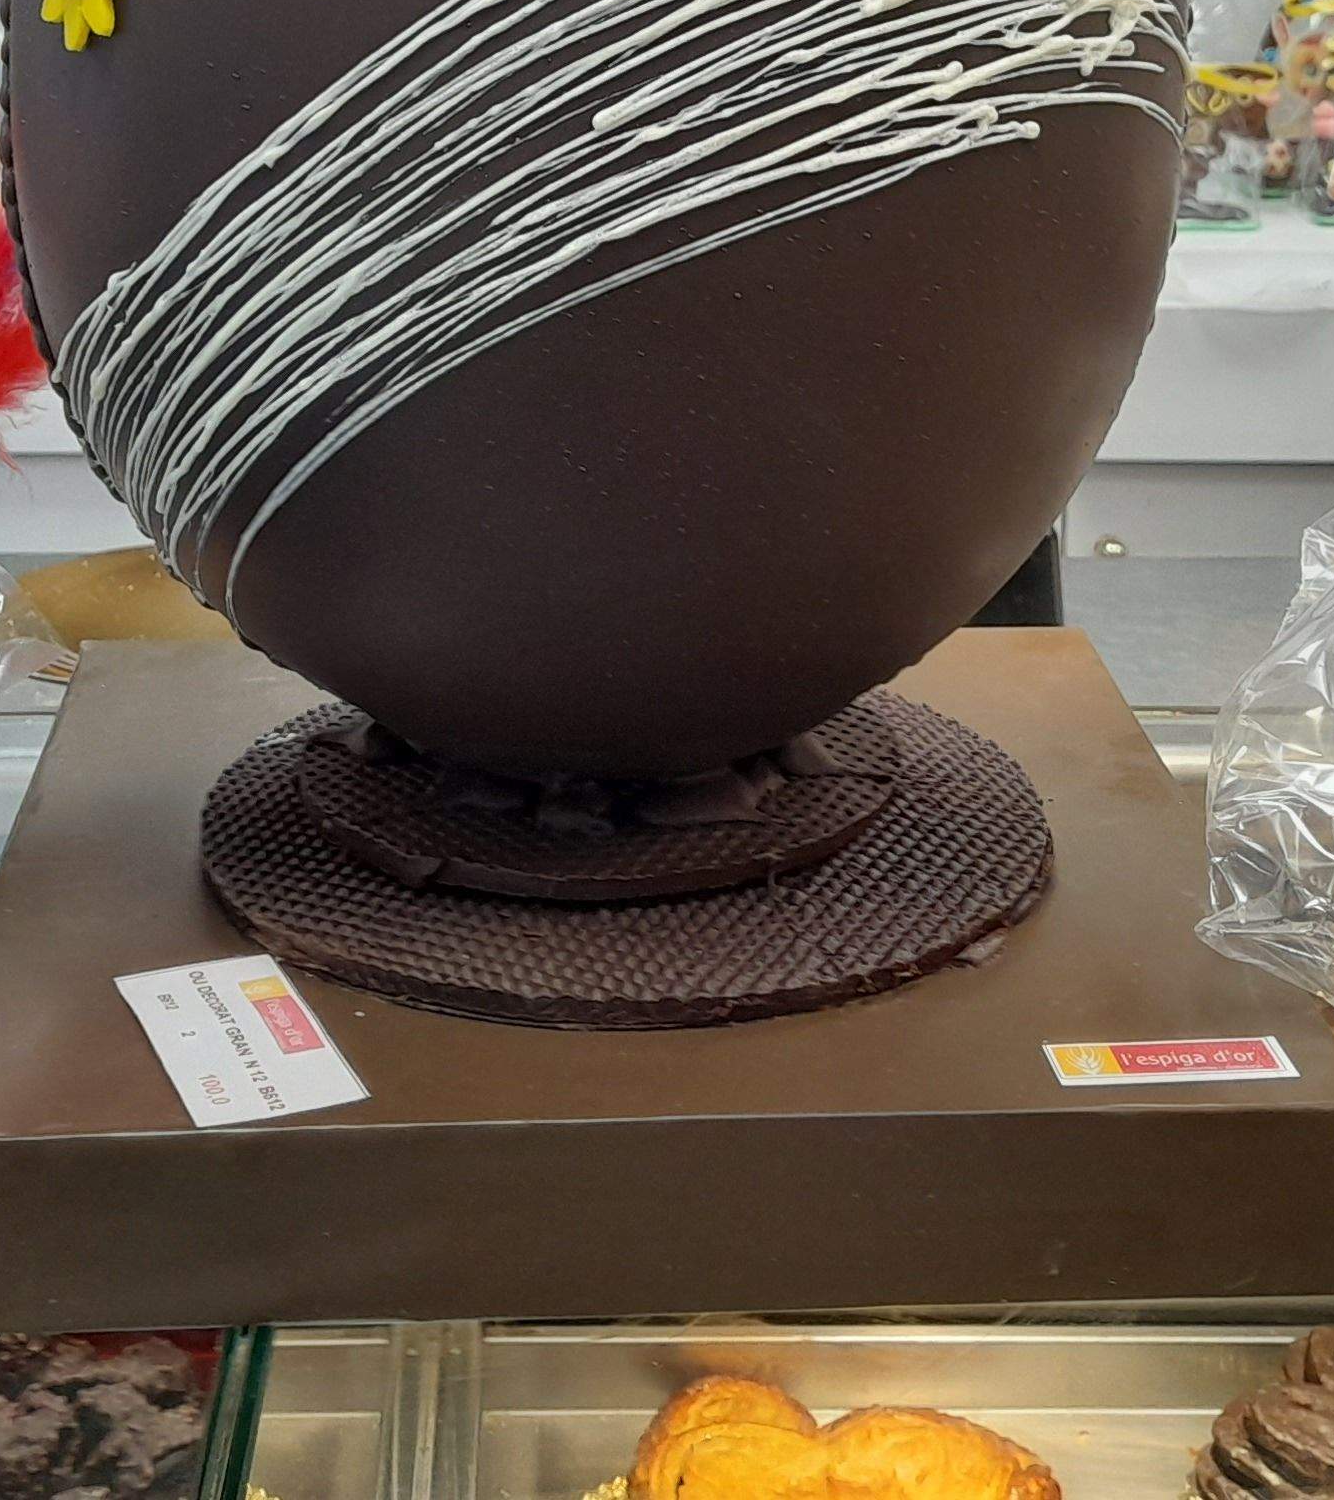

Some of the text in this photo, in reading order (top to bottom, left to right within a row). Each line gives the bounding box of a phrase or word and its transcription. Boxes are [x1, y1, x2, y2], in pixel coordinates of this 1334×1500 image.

[188, 970, 209, 985] OU
[197, 985, 237, 1024] DECORAT
[180, 1030, 196, 1038] 2
[225, 1026, 254, 1057] GRAN
[243, 1060, 260, 1069] N
[1120, 1049, 1255, 1067] l'espiga d'or
[249, 1070, 269, 1082] 12
